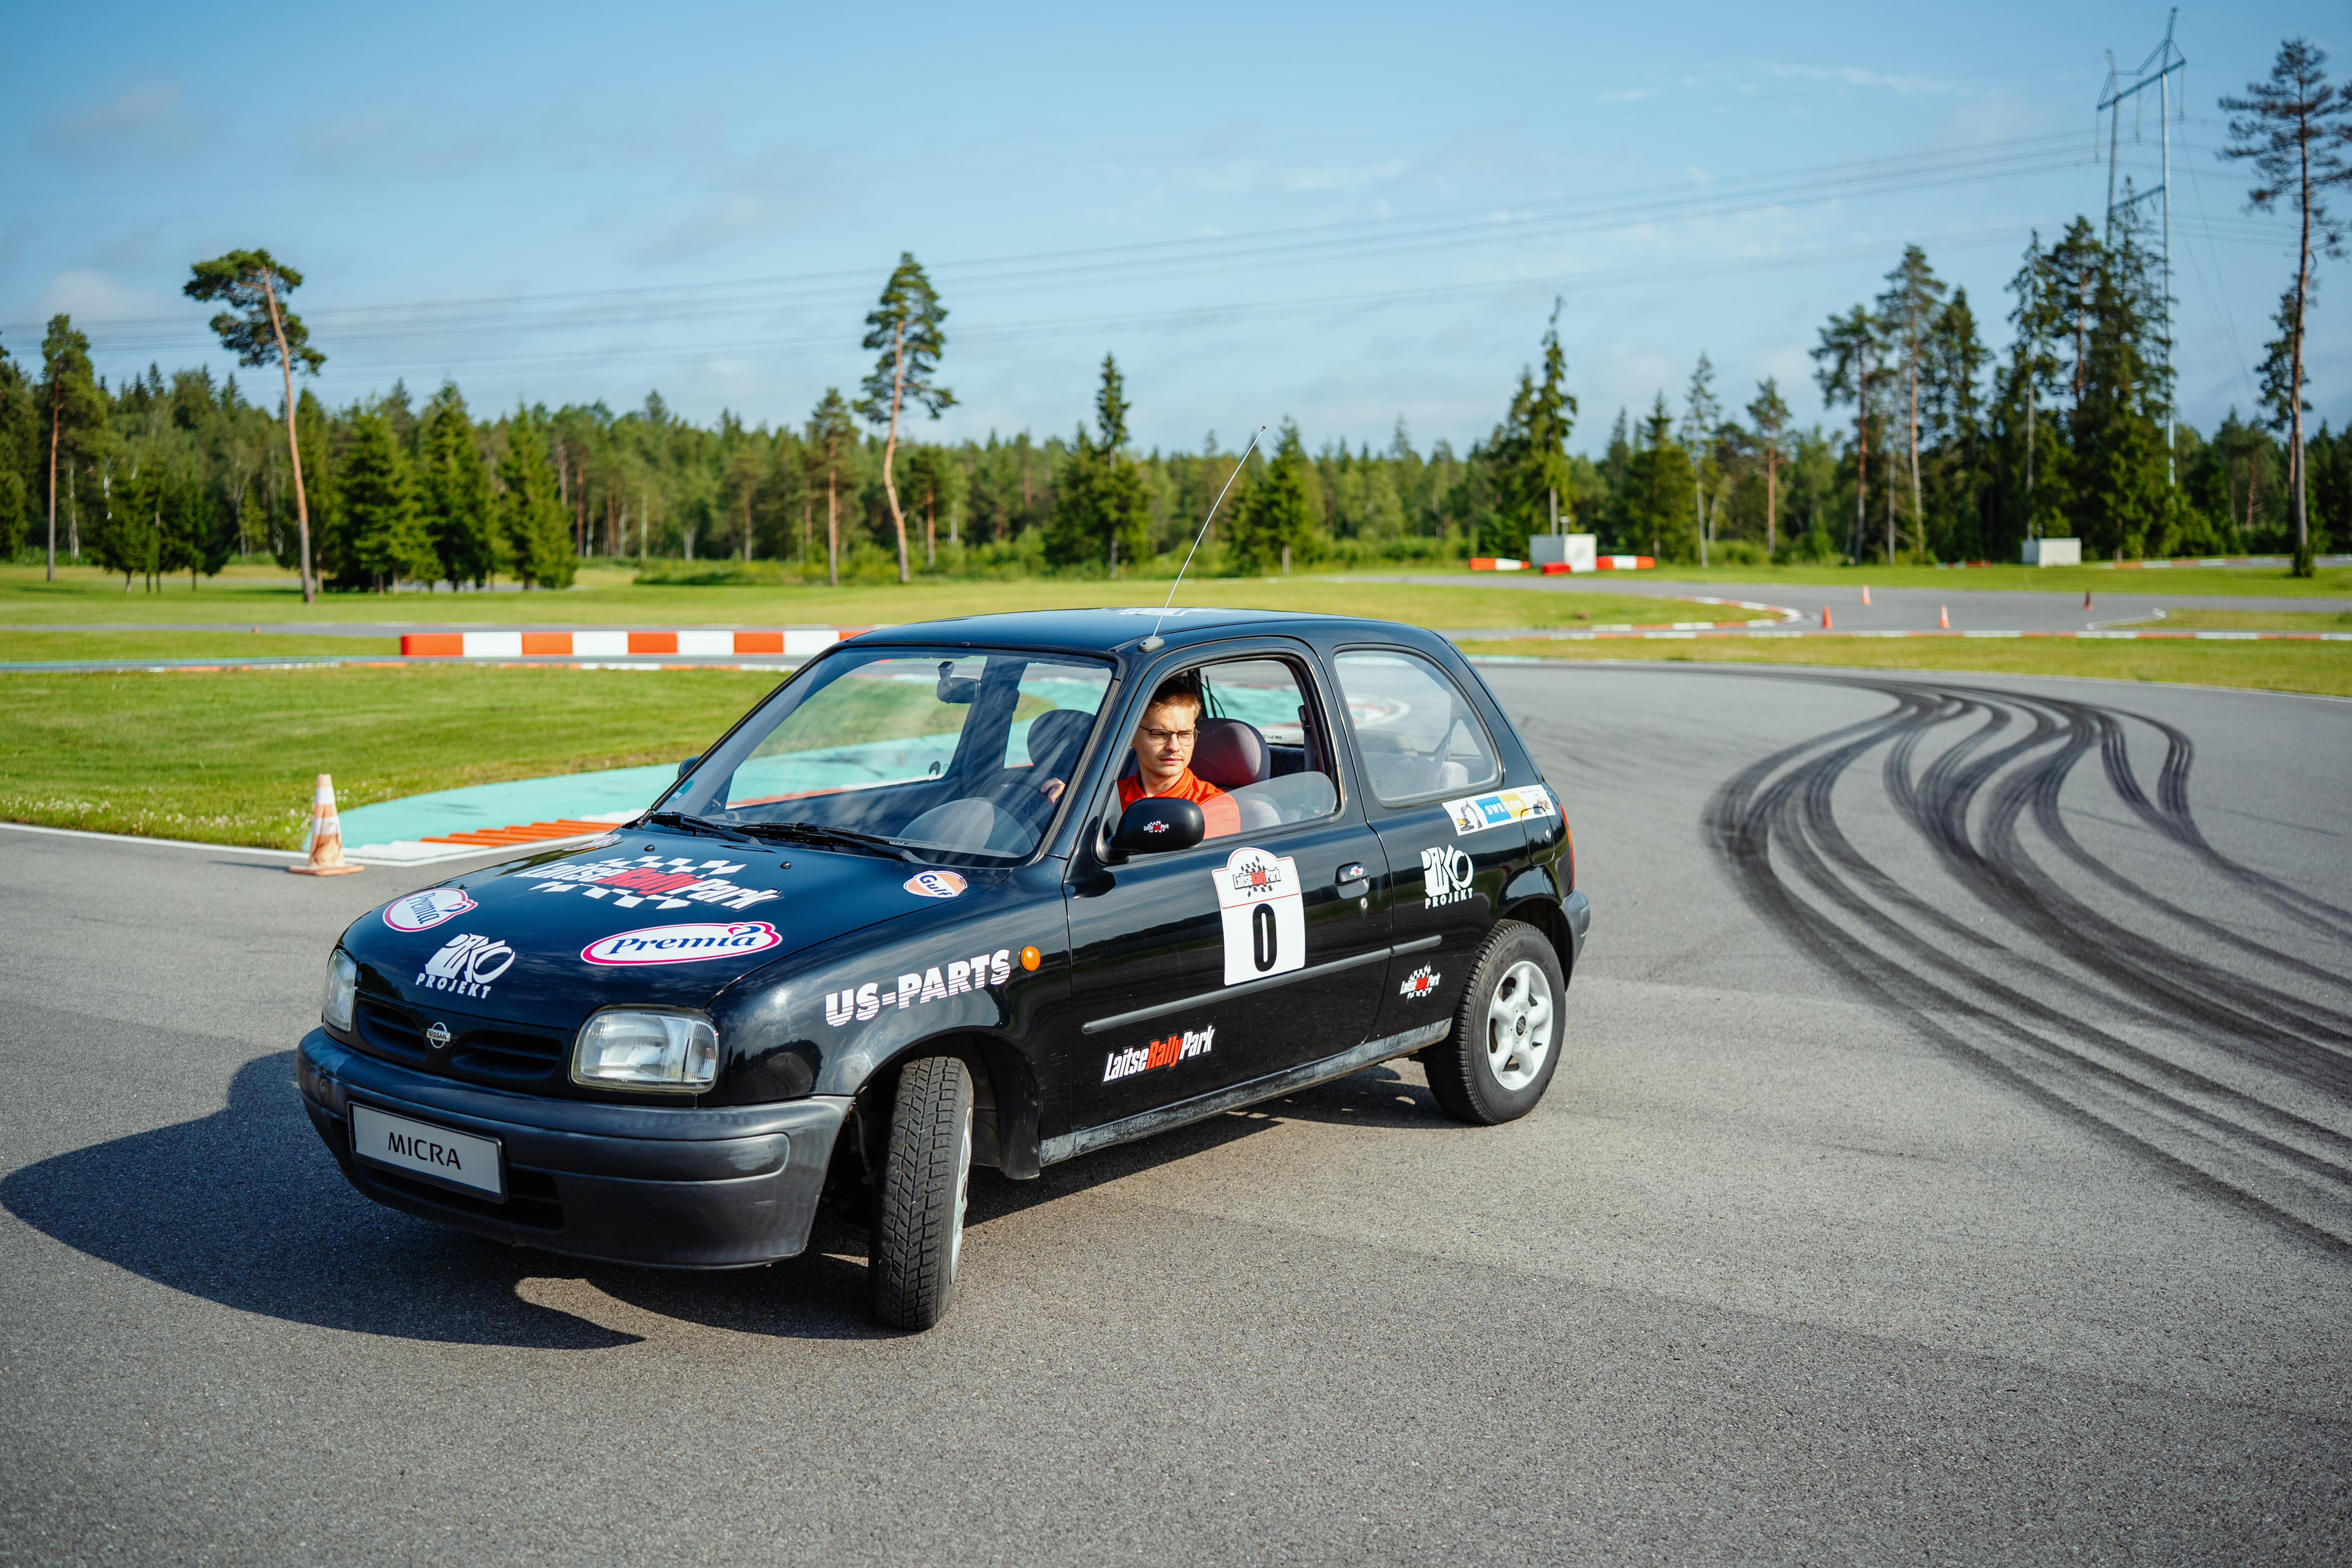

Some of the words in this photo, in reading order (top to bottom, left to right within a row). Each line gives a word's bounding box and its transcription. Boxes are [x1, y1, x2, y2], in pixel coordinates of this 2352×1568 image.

[1484, 799, 1523, 815] SWECON
[919, 875, 953, 896] Gulf
[406, 892, 440, 924] Premia
[1424, 887, 1473, 910] PROJEKT
[604, 937, 757, 955] Premia
[1253, 903, 1277, 972] 0
[415, 973, 491, 998] PROJEKT
[825, 949, 1011, 1027] US-PARTS
[428, 1031, 447, 1039] NISSAN
[388, 1132, 461, 1170] MICRA
